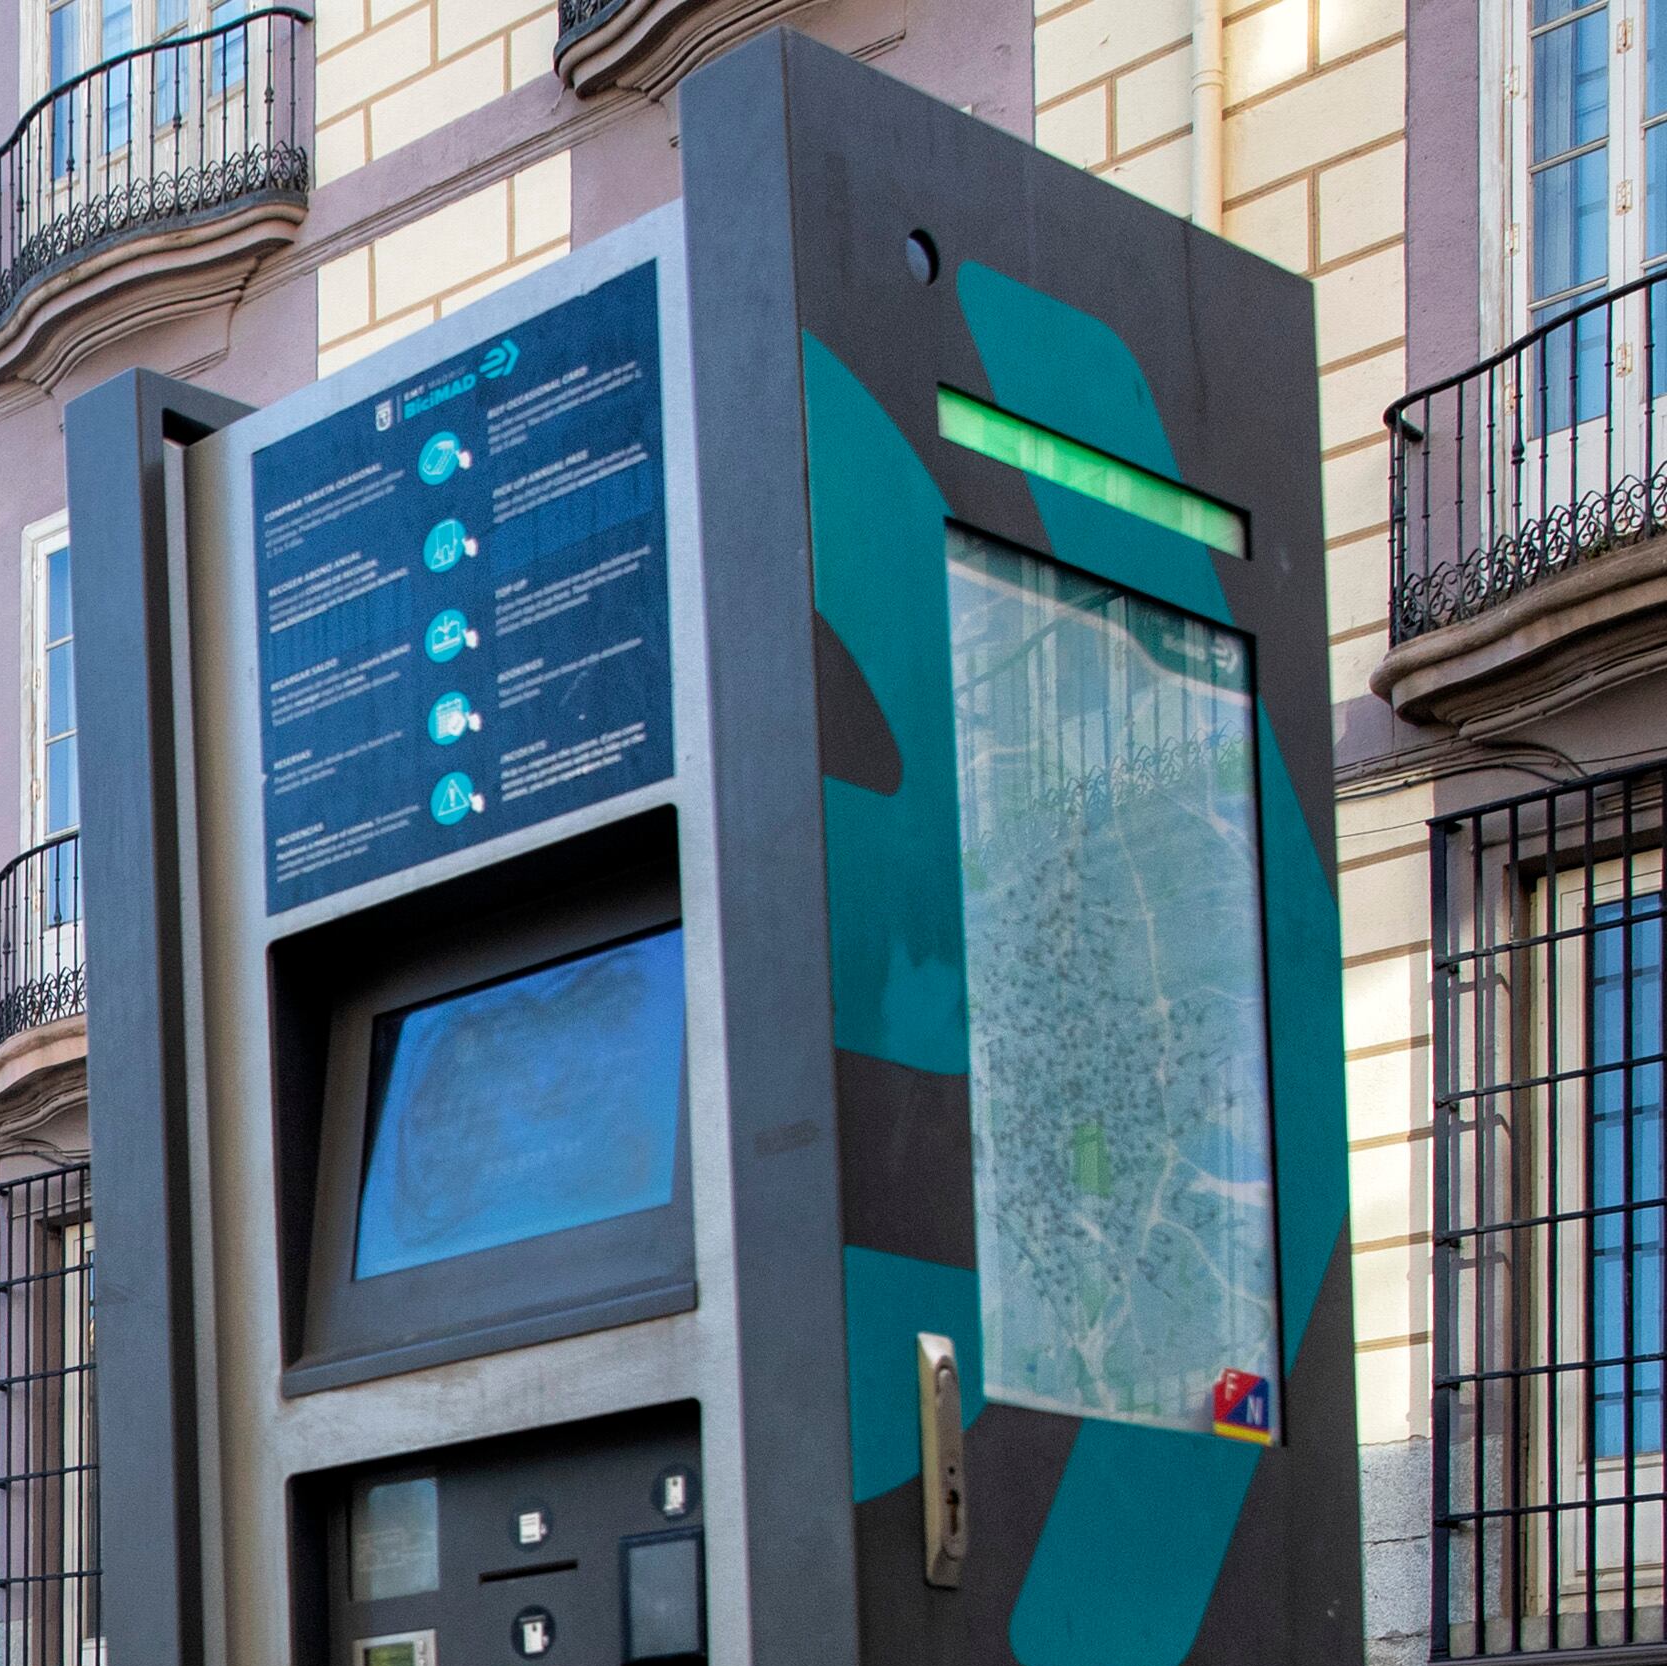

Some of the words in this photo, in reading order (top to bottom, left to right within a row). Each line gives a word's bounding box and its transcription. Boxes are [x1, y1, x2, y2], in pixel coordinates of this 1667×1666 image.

[561, 364, 587, 386] CARD
[403, 373, 477, 421] BiciMAD
[263, 498, 303, 522] COMPRAR
[303, 483, 335, 504] TARJETA
[335, 462, 382, 489] OCASIONAL
[267, 576, 303, 598] RECOGER
[303, 563, 332, 582] ABONO
[333, 550, 361, 569] ANUAL
[1225, 1373, 1238, 1401] F
[1246, 1394, 1264, 1426] N
